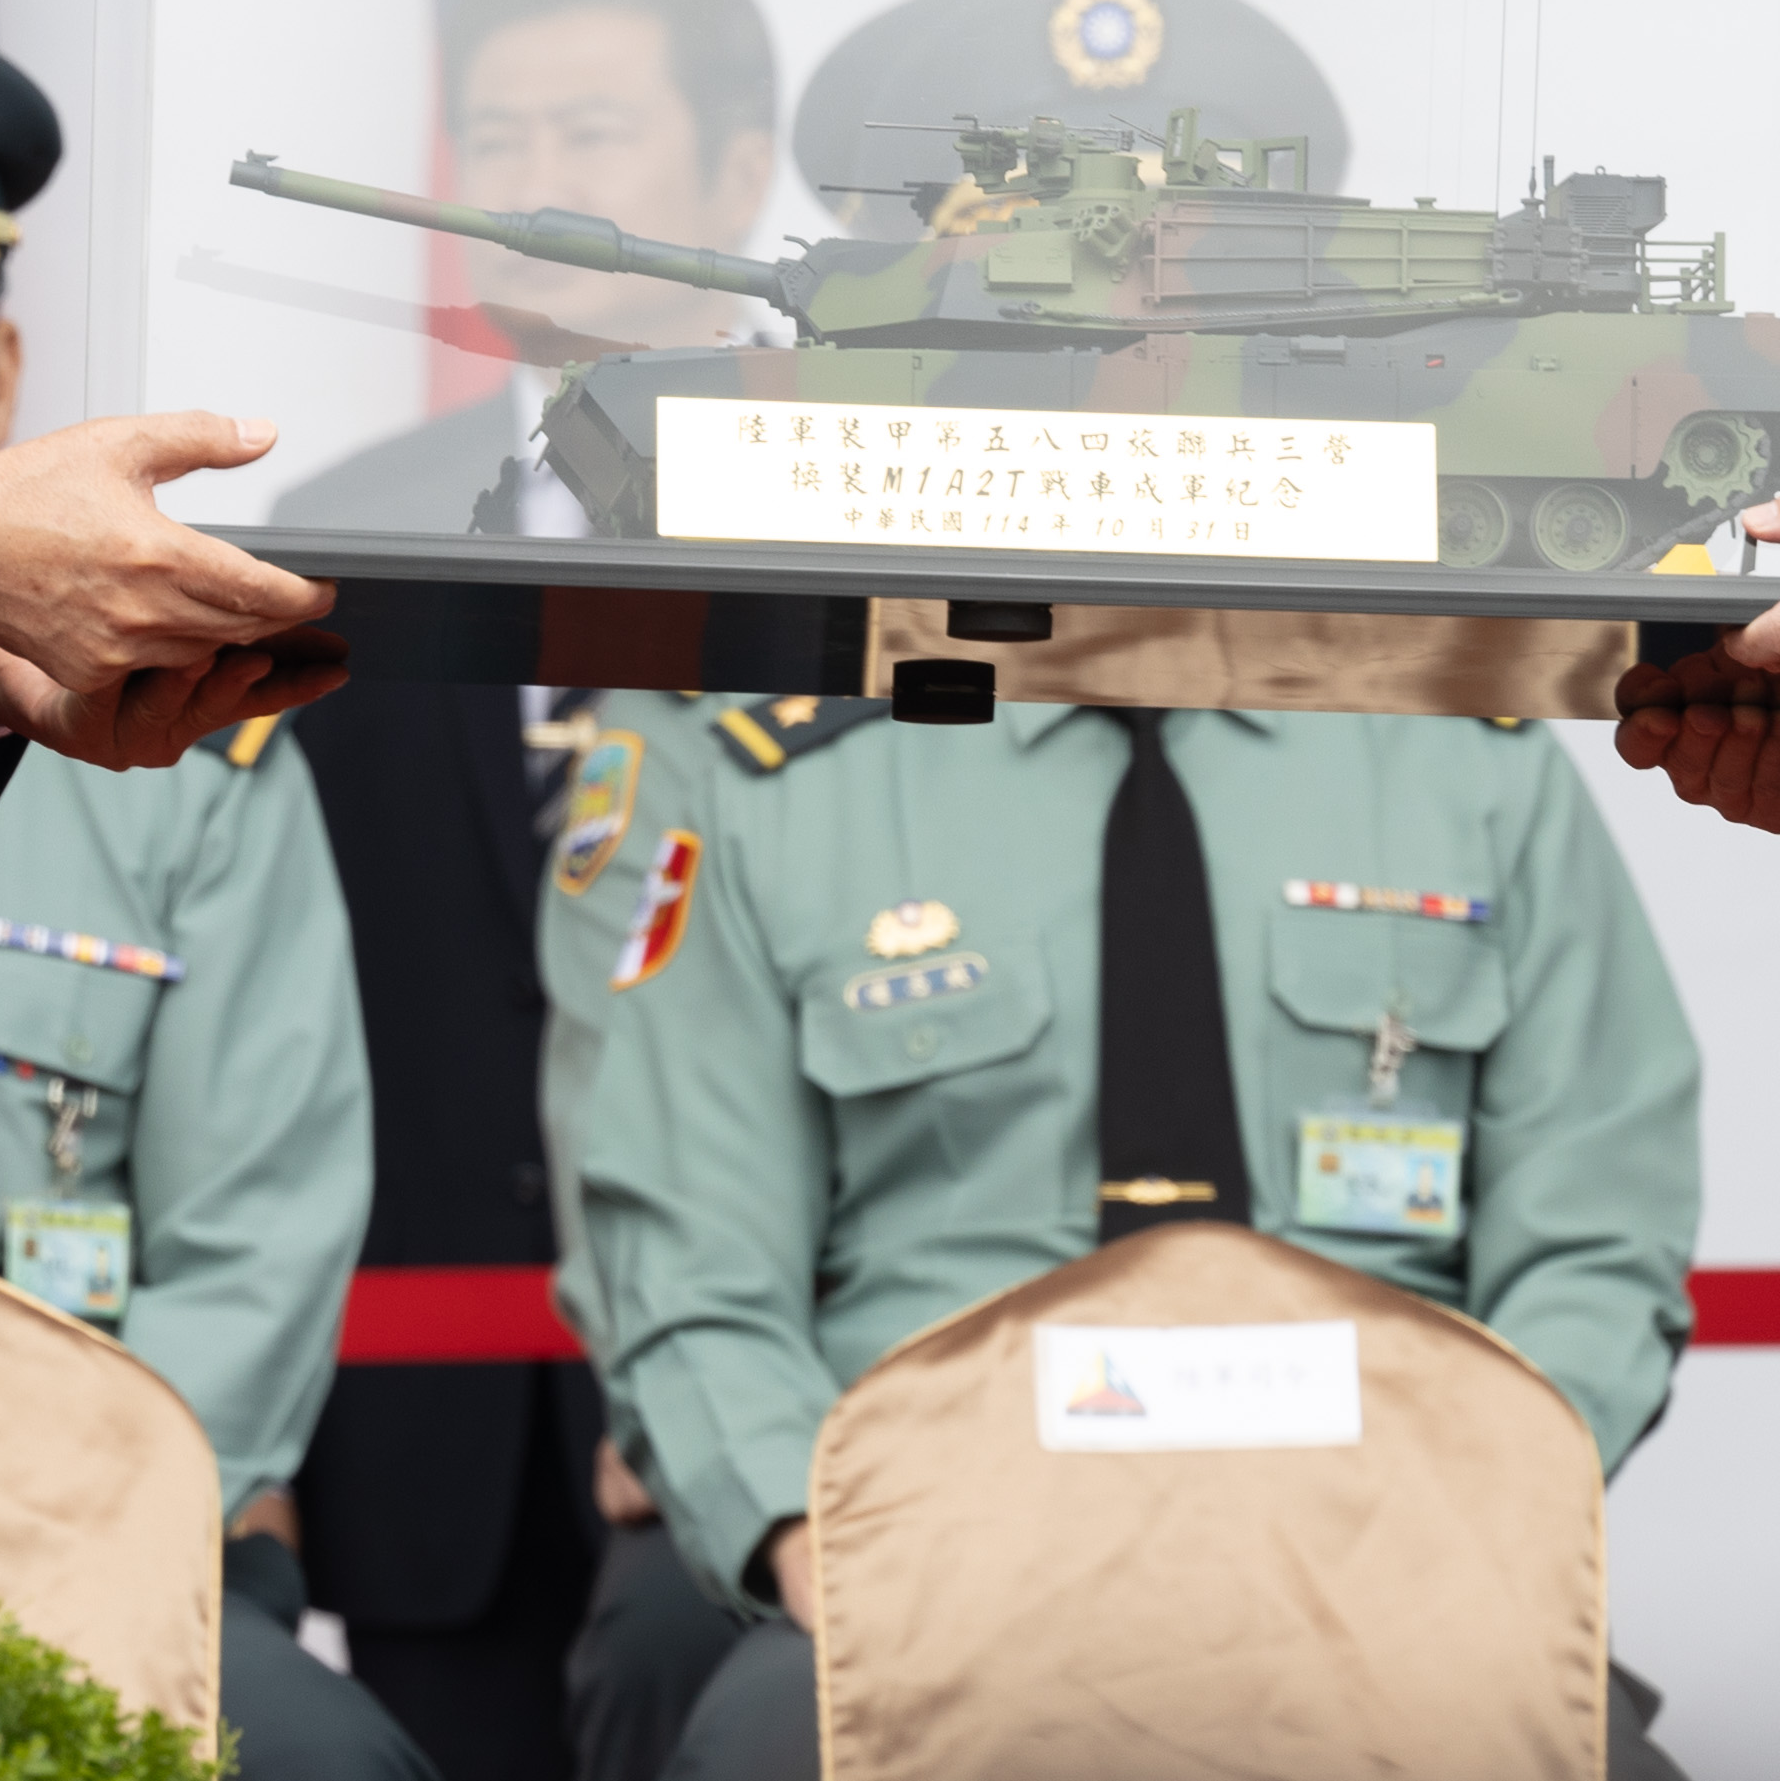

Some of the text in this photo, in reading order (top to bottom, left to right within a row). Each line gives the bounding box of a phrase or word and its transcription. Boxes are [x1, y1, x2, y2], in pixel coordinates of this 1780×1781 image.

[790, 461, 1304, 510] 換裝M1A2T戰車成軍紀念
